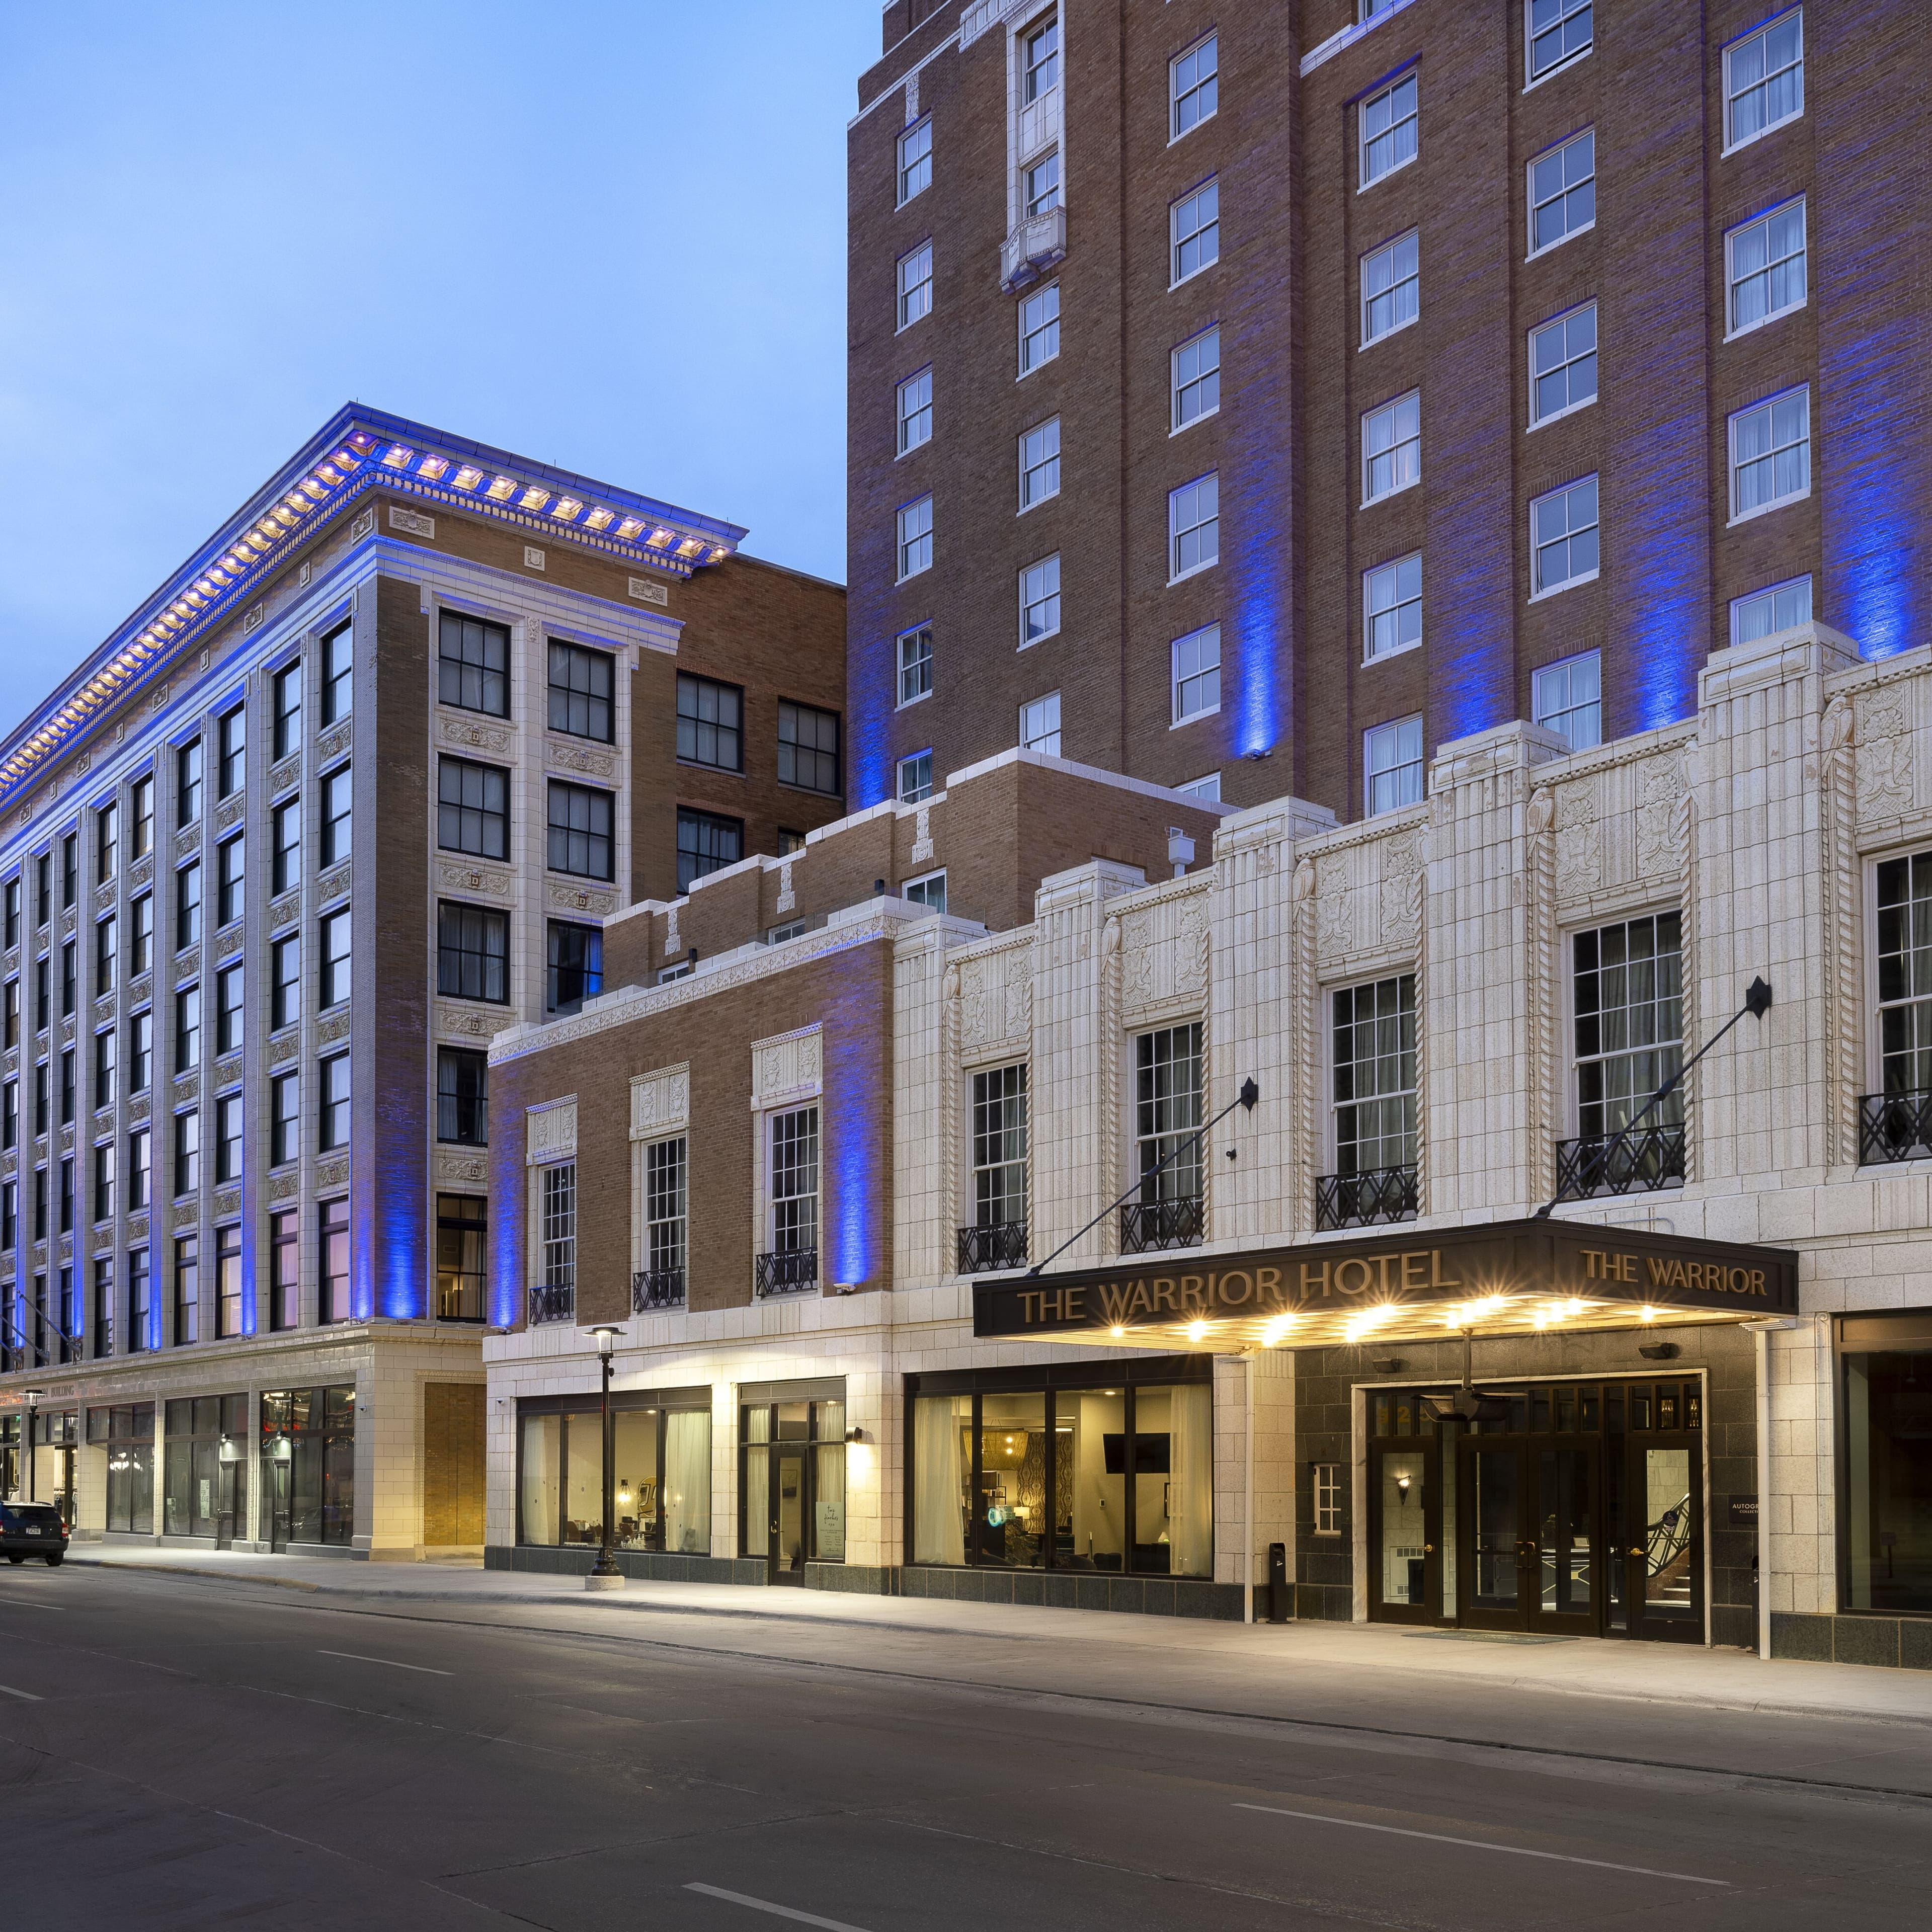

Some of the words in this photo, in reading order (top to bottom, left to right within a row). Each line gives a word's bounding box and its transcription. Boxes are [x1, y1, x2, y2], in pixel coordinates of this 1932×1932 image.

[1016, 1286, 1087, 1324] THE
[1098, 1267, 1284, 1317] WARRIOR
[1300, 1249, 1462, 1300] HOTEL
[1579, 1250, 1638, 1283] THE
[1646, 1257, 1767, 1296] WARRIOR
[51, 1385, 74, 1397] BUILDING
